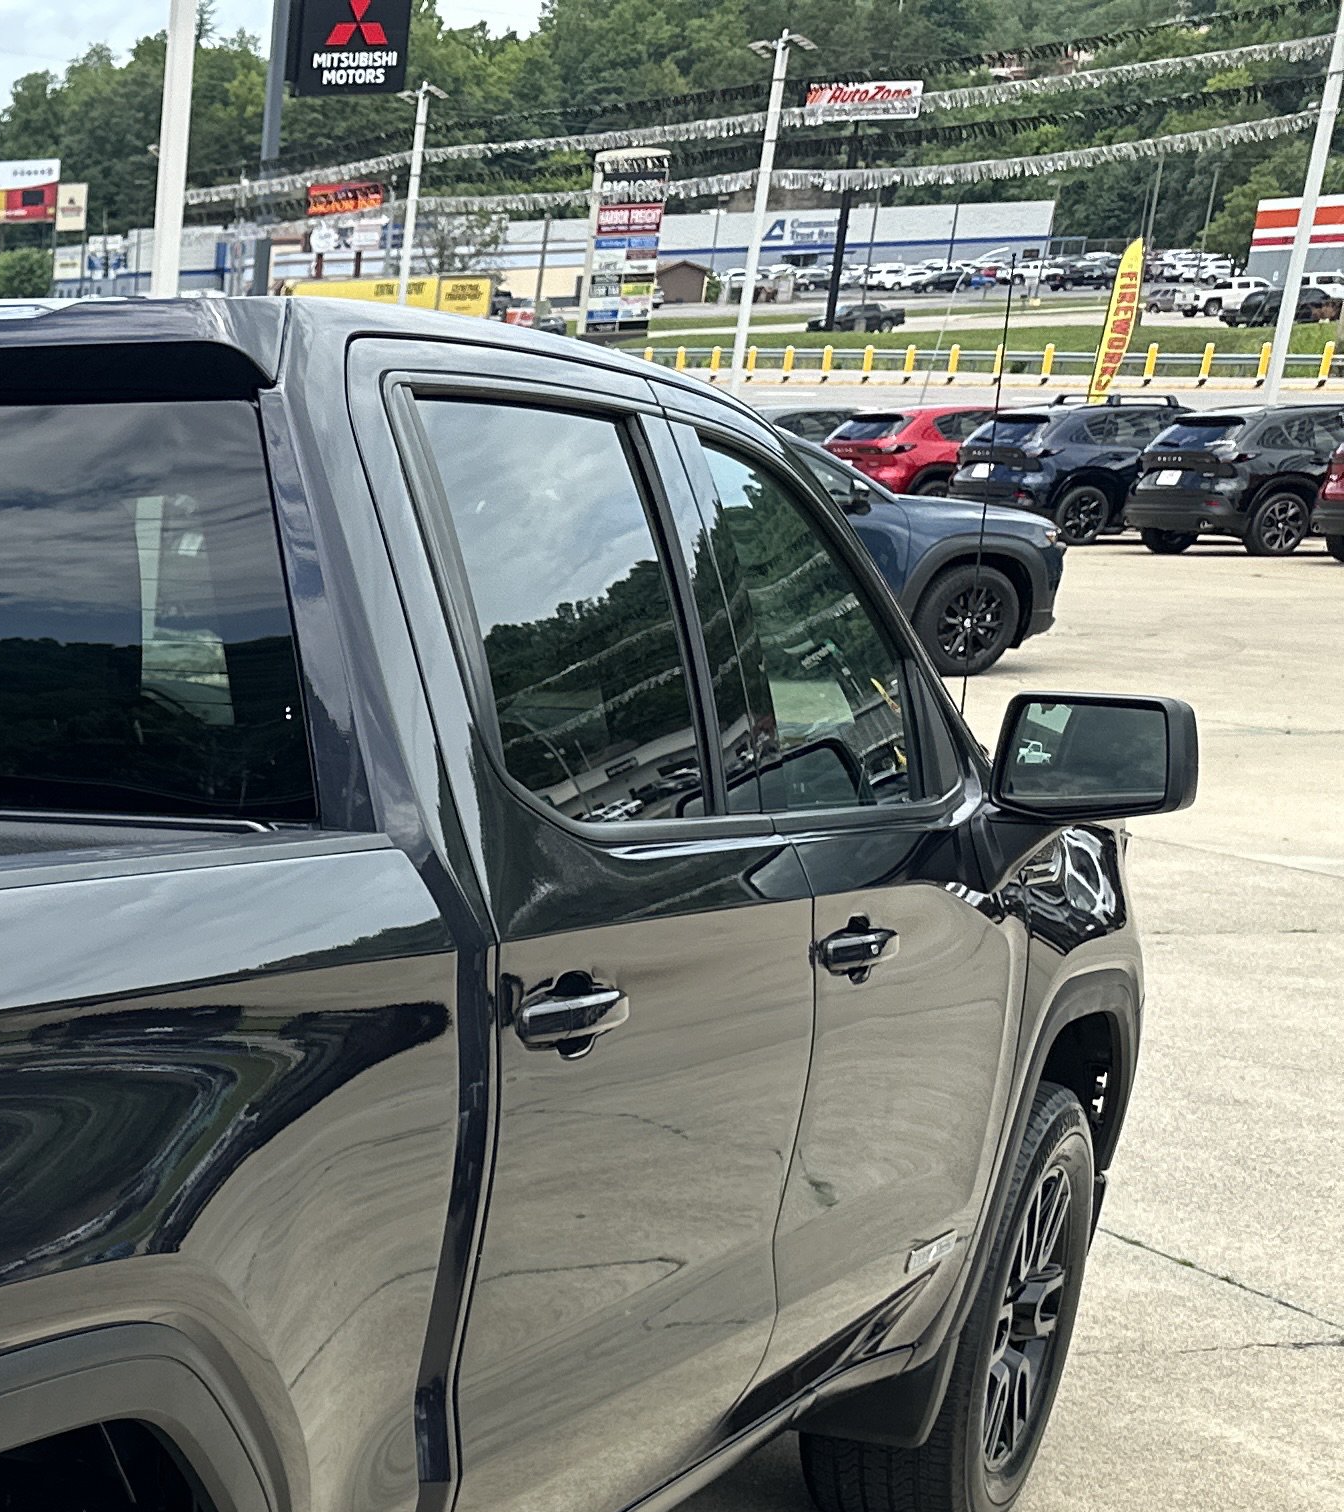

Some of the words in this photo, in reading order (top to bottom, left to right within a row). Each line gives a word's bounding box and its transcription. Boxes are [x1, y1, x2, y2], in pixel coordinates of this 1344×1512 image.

[312, 51, 398, 69] MITSUBISHI
[321, 68, 386, 85] MOTORS
[827, 85, 912, 104] AutoZone
[1094, 271, 1139, 392] FIREWORKS
